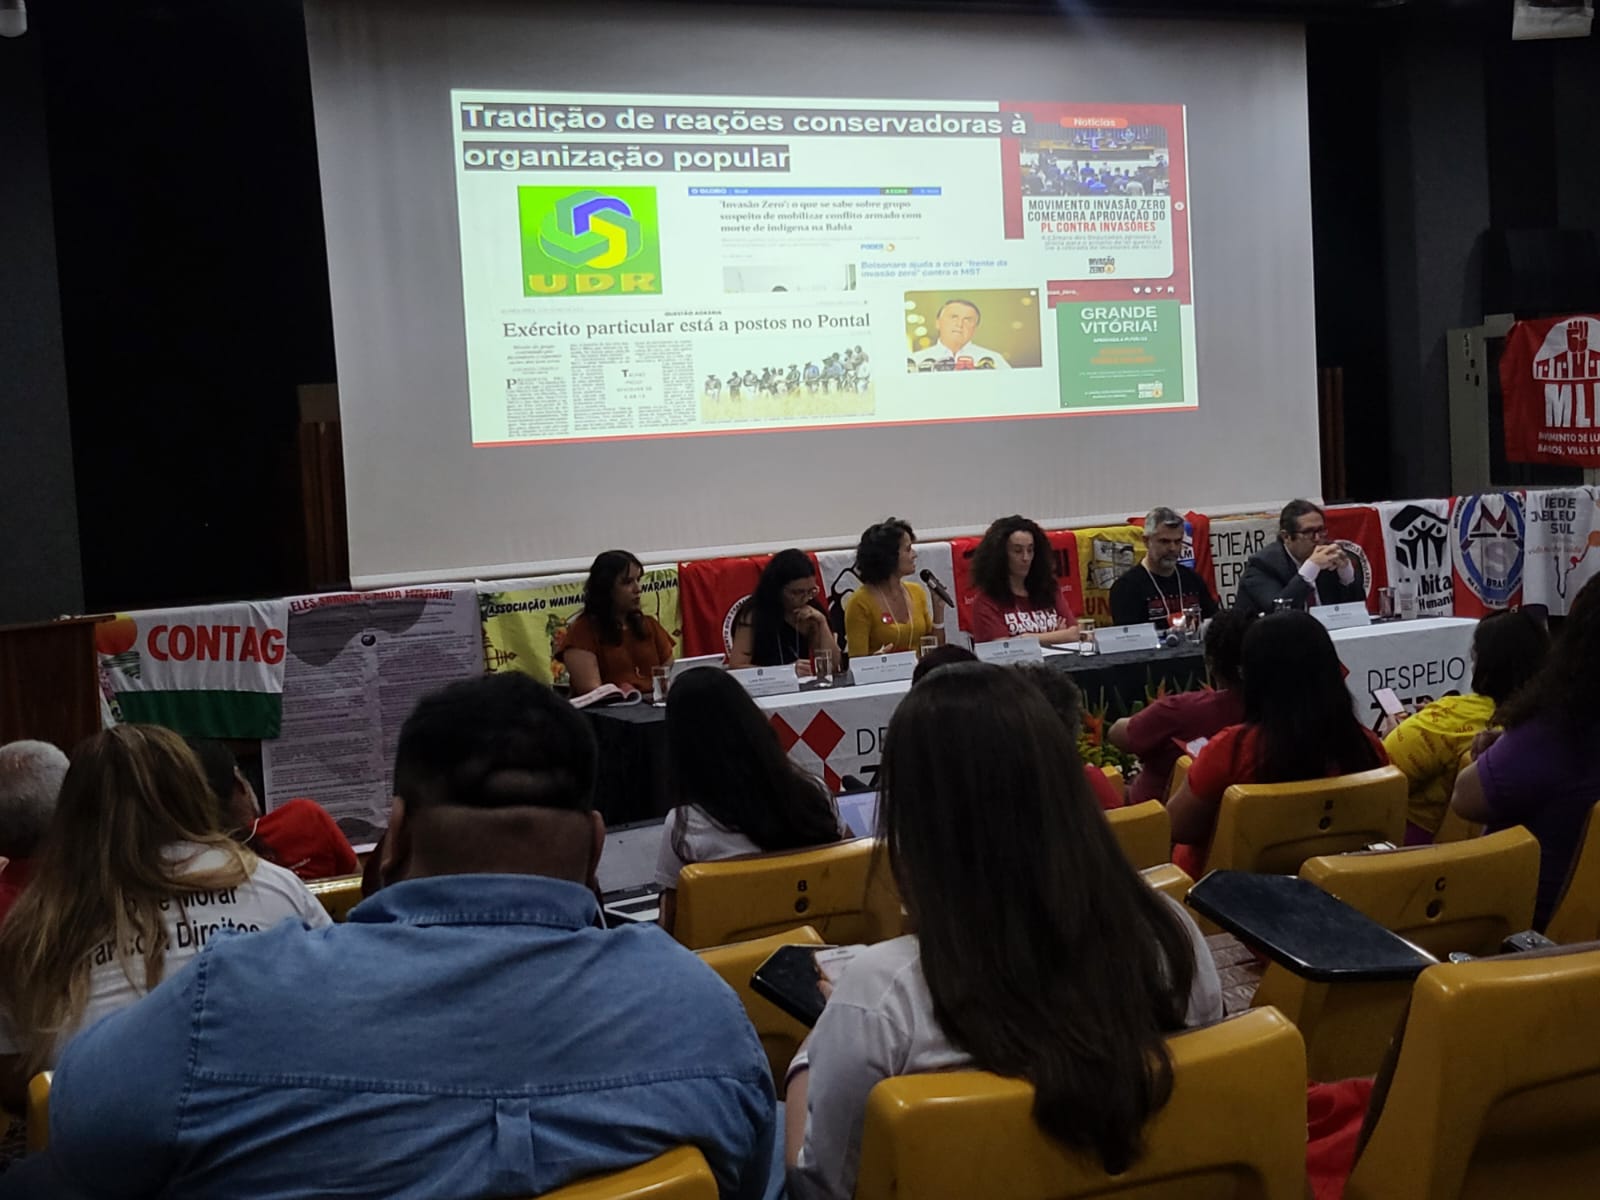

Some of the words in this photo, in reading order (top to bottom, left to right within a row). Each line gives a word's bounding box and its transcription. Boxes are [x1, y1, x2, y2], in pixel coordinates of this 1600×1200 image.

[463, 104, 606, 133] Tradição
[616, 108, 655, 130] de
[665, 110, 784, 135] reações
[793, 113, 1003, 134] conservadoras
[1011, 113, 1027, 135] à
[464, 145, 664, 171] organização
[674, 146, 790, 172] popular
[799, 201, 818, 210] que
[820, 201, 831, 209] se
[832, 200, 854, 208] sabe
[855, 199, 881, 208] sobre
[882, 200, 911, 210] grupo
[1028, 199, 1091, 210] MOVIMENTO
[1093, 198, 1138, 210] INVASÃO
[1140, 199, 1166, 210] ZERO
[720, 212, 762, 221] suspeito
[763, 212, 775, 220] de
[777, 211, 824, 220] mobilizar
[825, 211, 863, 220] conflito
[864, 211, 900, 219] armado
[1027, 211, 1087, 222] COMEMORA
[1089, 210, 1149, 222] APROVAÇÃO
[1151, 210, 1166, 221] DO
[720, 224, 751, 232] morte
[752, 223, 766, 232] de
[811, 224, 824, 232] na
[825, 222, 853, 231] Bahia
[1040, 221, 1054, 233] PL
[1056, 221, 1097, 233] CONTRA
[1100, 220, 1156, 232] INVASORES
[861, 261, 907, 270] Bolsonaro
[908, 260, 934, 270] ajuda
[943, 260, 963, 268] criar
[996, 259, 1008, 267] da
[861, 269, 896, 278] invasão
[922, 268, 951, 277] contra
[960, 268, 981, 276] MST
[528, 272, 656, 294] UDR
[1080, 306, 1158, 320] GRANDE
[503, 321, 580, 338] Exército
[587, 319, 675, 339] particular
[680, 317, 713, 332] está
[719, 321, 729, 331] a
[735, 318, 787, 334] postos
[792, 318, 812, 329] no
[817, 313, 871, 329] Pontal
[1080, 319, 1158, 334] VITÓRIA!
[1550, 522, 1575, 534] SUL
[1417, 573, 1453, 597] bita
[290, 598, 318, 612] ELES
[487, 598, 546, 617] ASSOCIAÇÃO
[1085, 596, 1109, 616] UN
[147, 624, 285, 665] CONTAG
[1367, 656, 1466, 694] DESPEJO
[1435, 877, 1446, 892] C
